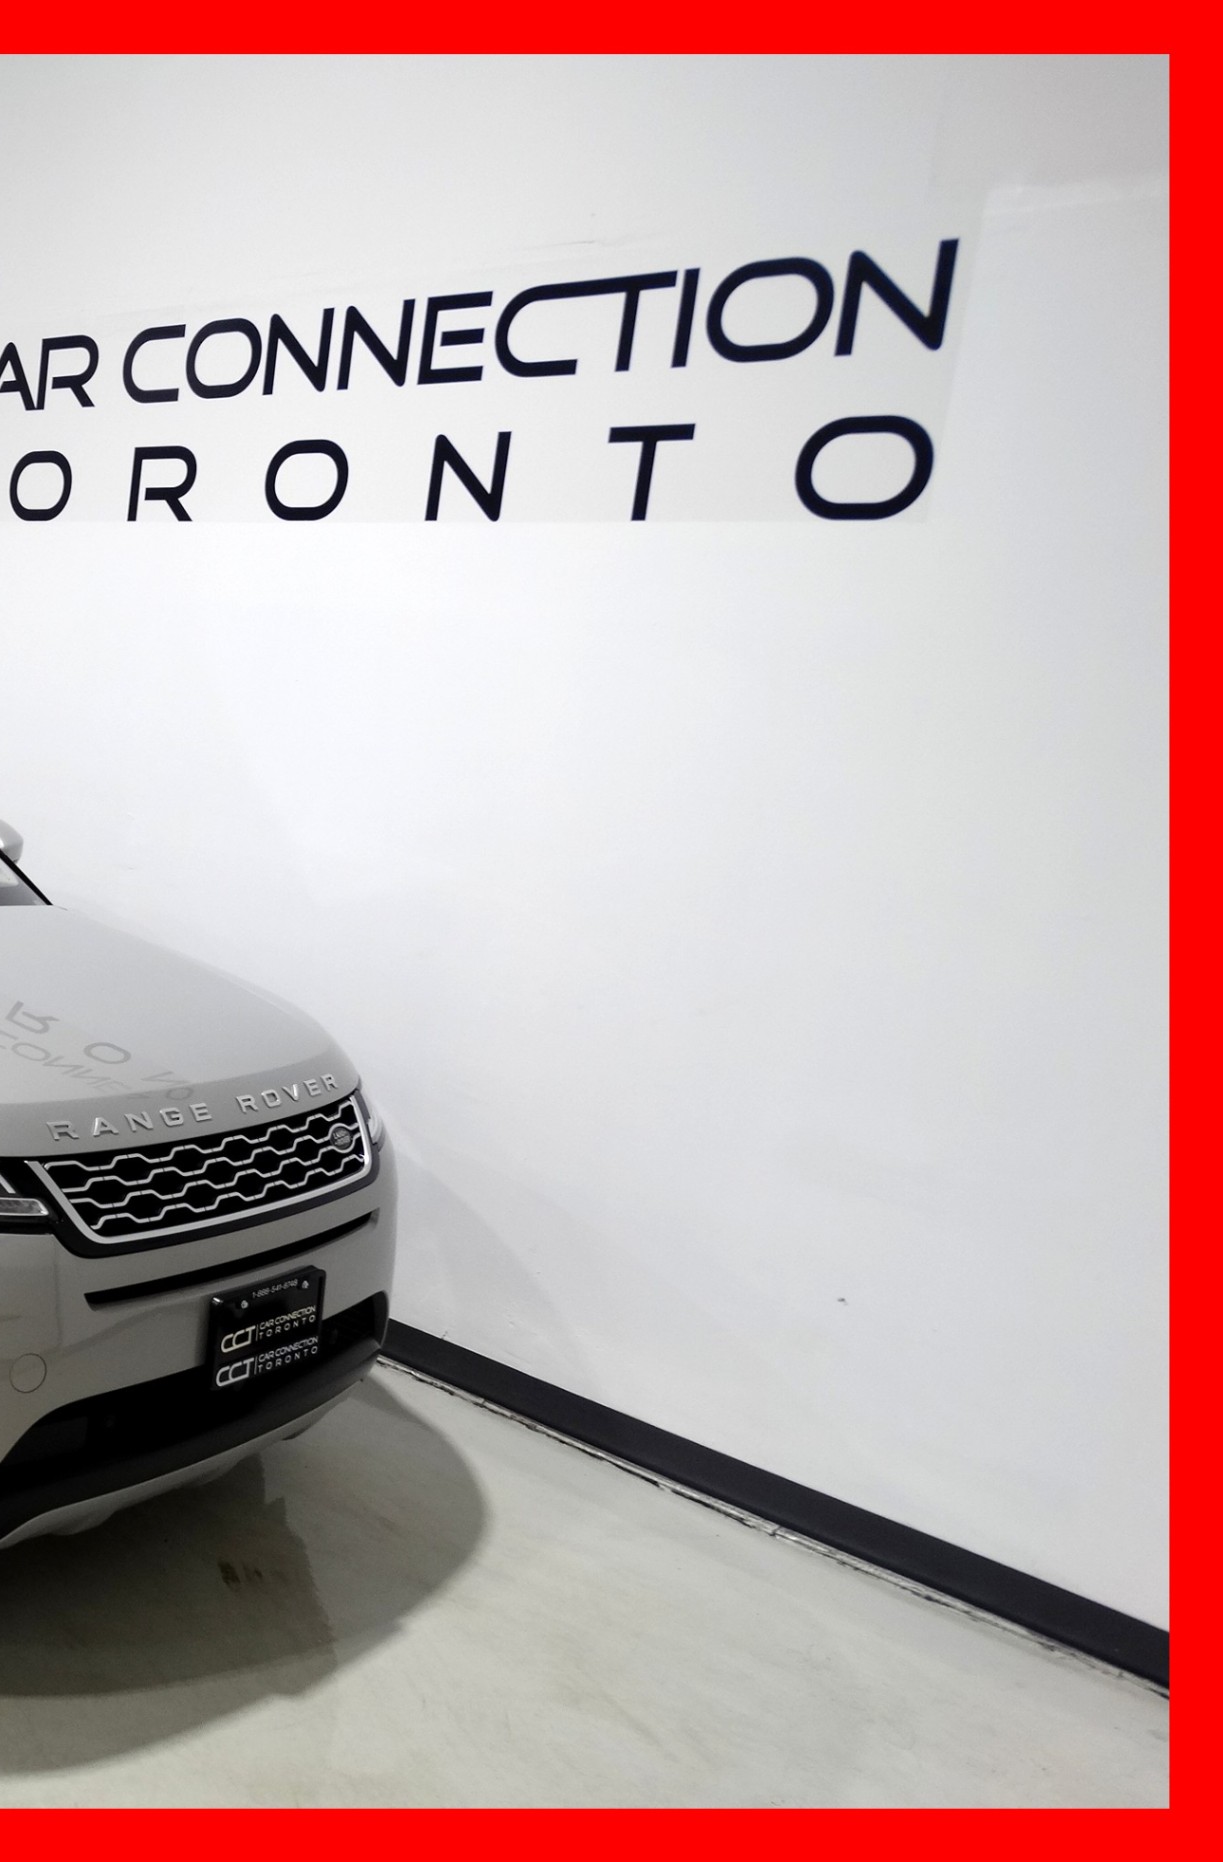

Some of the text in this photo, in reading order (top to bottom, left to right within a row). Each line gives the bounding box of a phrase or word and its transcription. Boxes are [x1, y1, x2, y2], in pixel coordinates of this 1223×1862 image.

[122, 238, 960, 404] CONNECTION
[46, 1073, 339, 1142] RANGE ROVER
[259, 1305, 316, 1330] CAR CONNECTION
[259, 1314, 316, 1339] TORONTO
[221, 1325, 256, 1353] CCT
[258, 1336, 319, 1363] CAR CONNECTION
[216, 1357, 255, 1387] CCT
[258, 1346, 319, 1373] TORONTO
